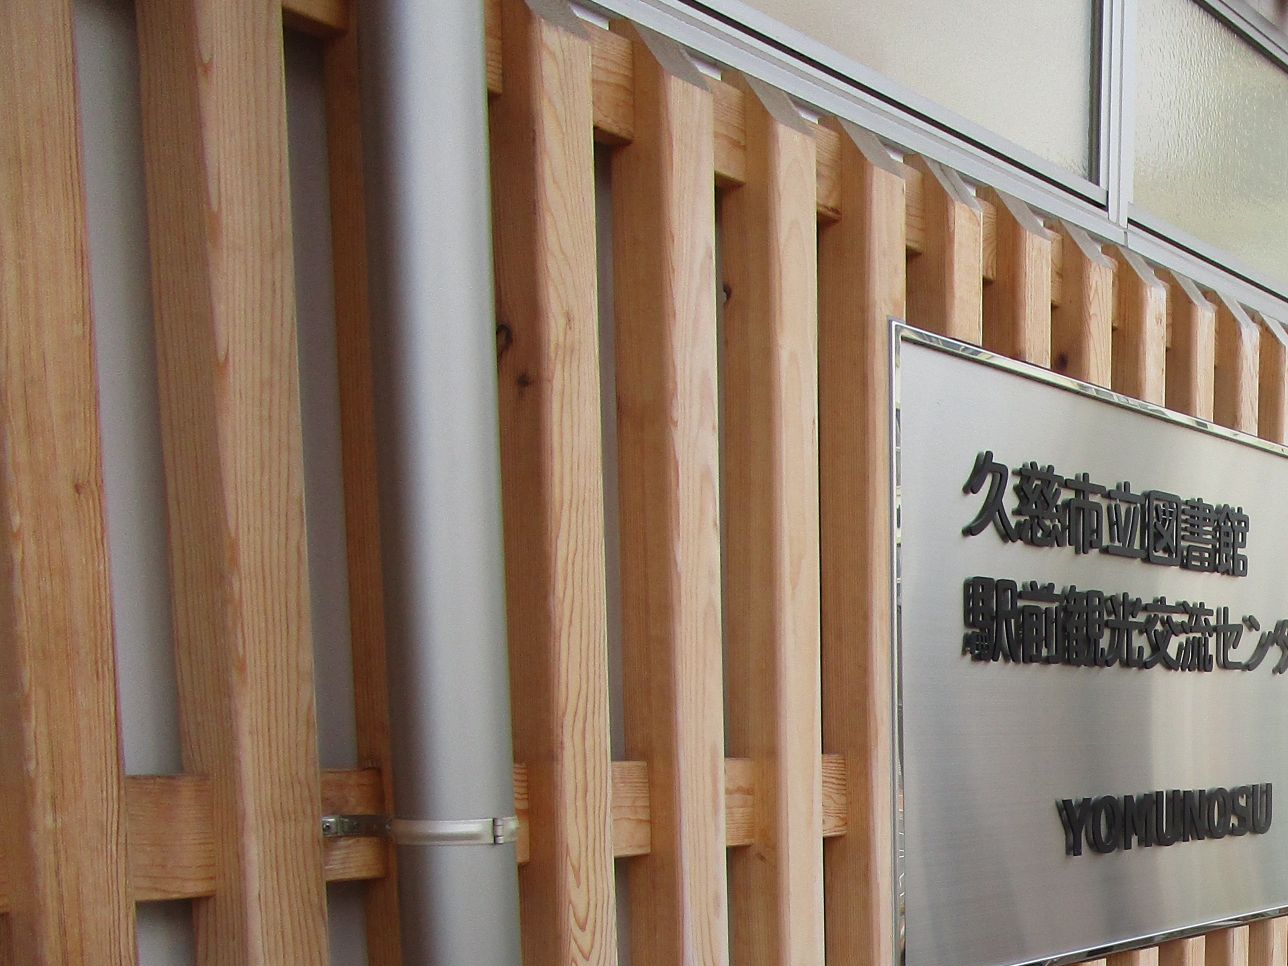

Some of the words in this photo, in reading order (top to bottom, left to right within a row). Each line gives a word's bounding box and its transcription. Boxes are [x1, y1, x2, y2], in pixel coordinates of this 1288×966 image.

[962, 450, 1249, 577] 久慈市立図書館
[1056, 783, 1273, 856] YOMUNOSU
